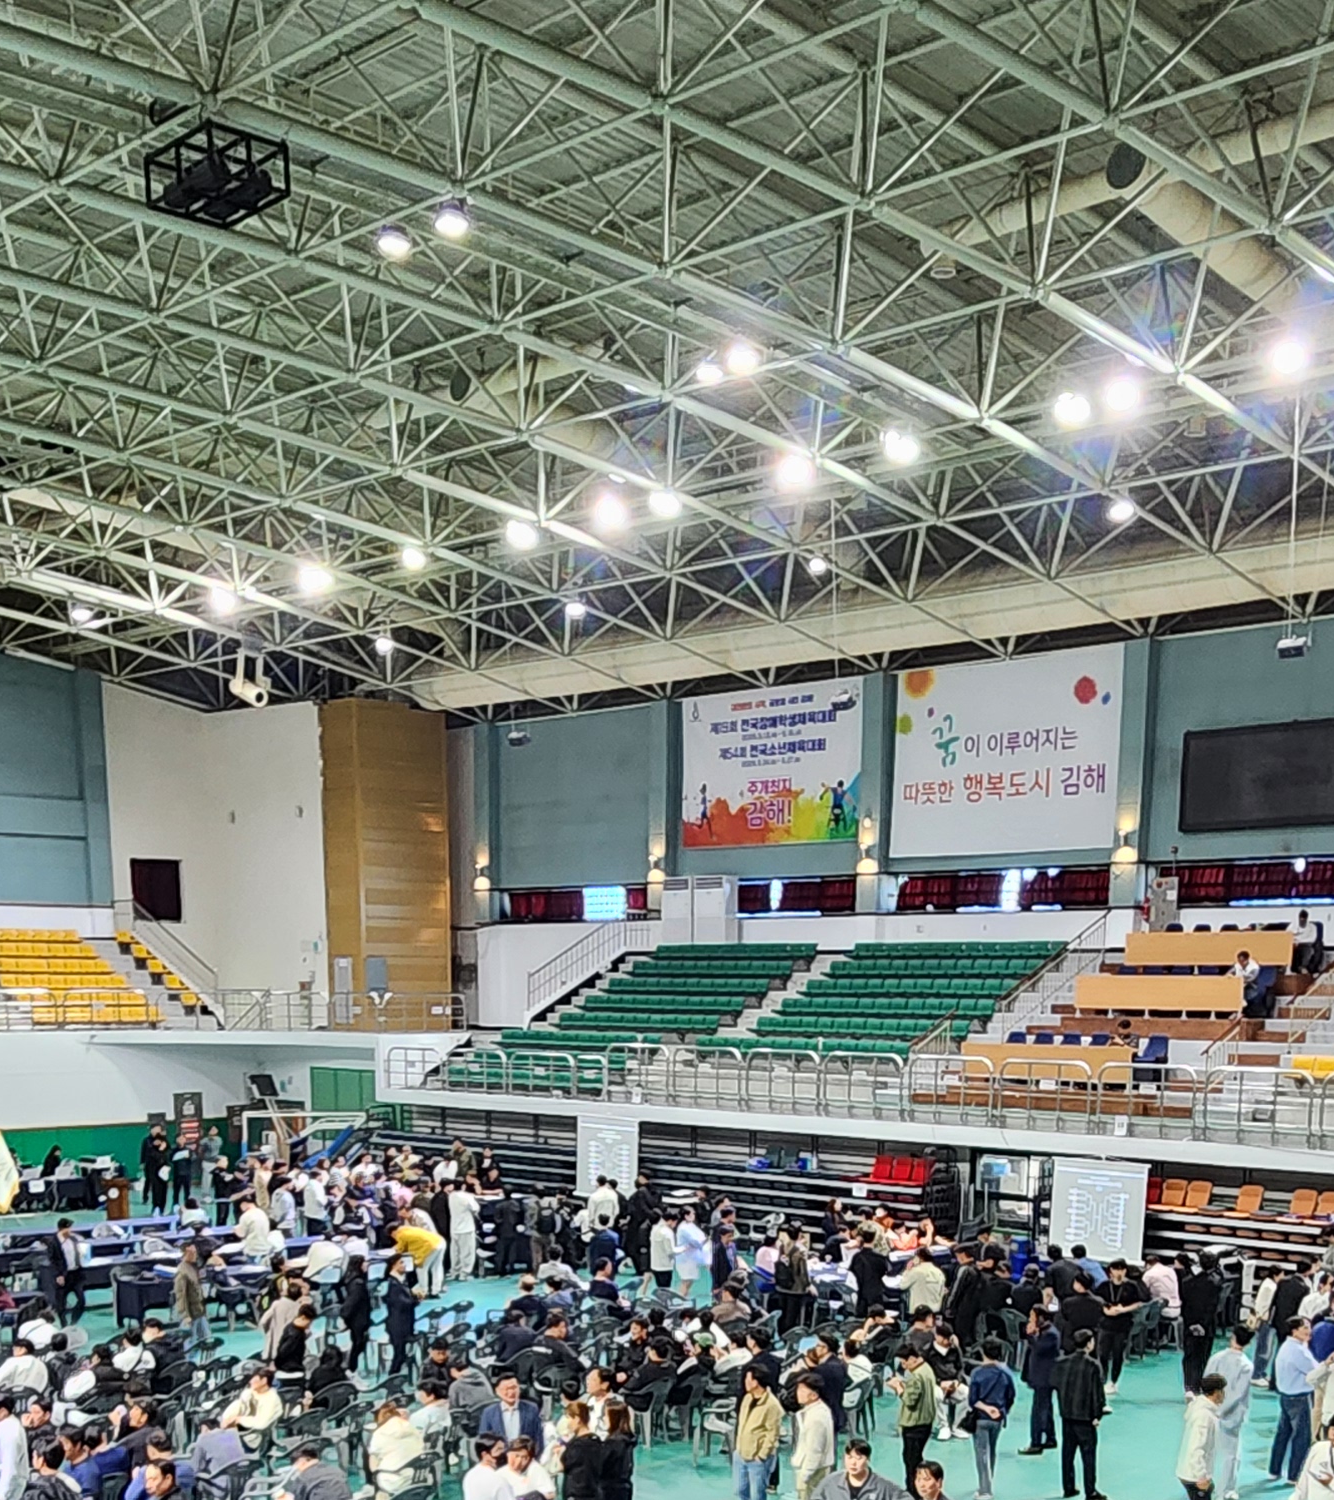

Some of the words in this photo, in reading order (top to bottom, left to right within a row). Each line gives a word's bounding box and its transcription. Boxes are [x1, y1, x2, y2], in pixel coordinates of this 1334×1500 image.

[750, 738, 826, 757] 전국소년체육대회
[987, 726, 1079, 757] 이루어지는
[747, 777, 792, 795] 주개최지
[903, 779, 955, 806] 따뜻한
[963, 767, 1051, 803] 행복도시
[1060, 763, 1107, 797] 김해
[747, 799, 792, 827] 김해!
